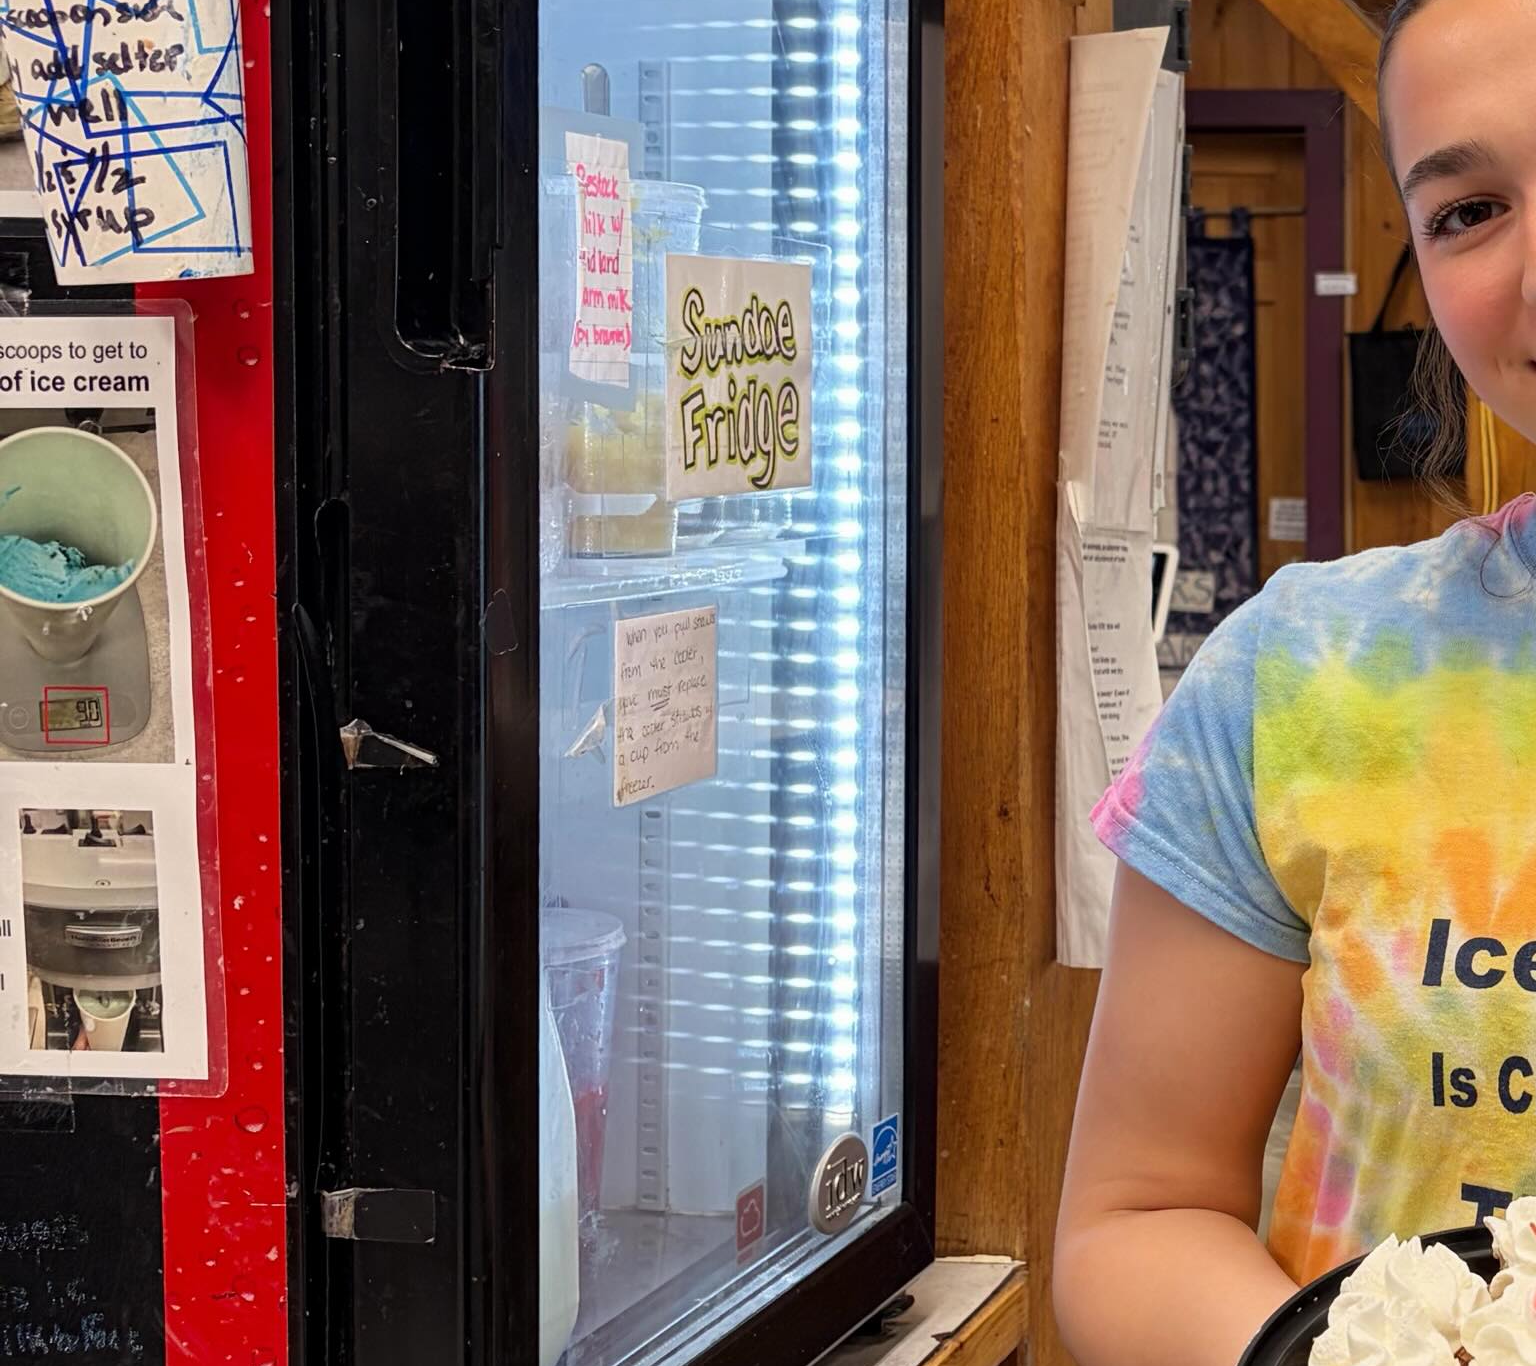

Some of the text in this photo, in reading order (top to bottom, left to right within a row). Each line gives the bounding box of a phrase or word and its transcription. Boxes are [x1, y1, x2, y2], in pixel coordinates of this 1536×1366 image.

[69, 342, 86, 360] to
[93, 343, 123, 364] get
[130, 343, 148, 360] to
[681, 288, 797, 375] Sundae
[31, 370, 65, 392] ice
[74, 370, 150, 392] cream
[681, 379, 799, 489] Fridge
[1432, 1051, 1478, 1108] Is
